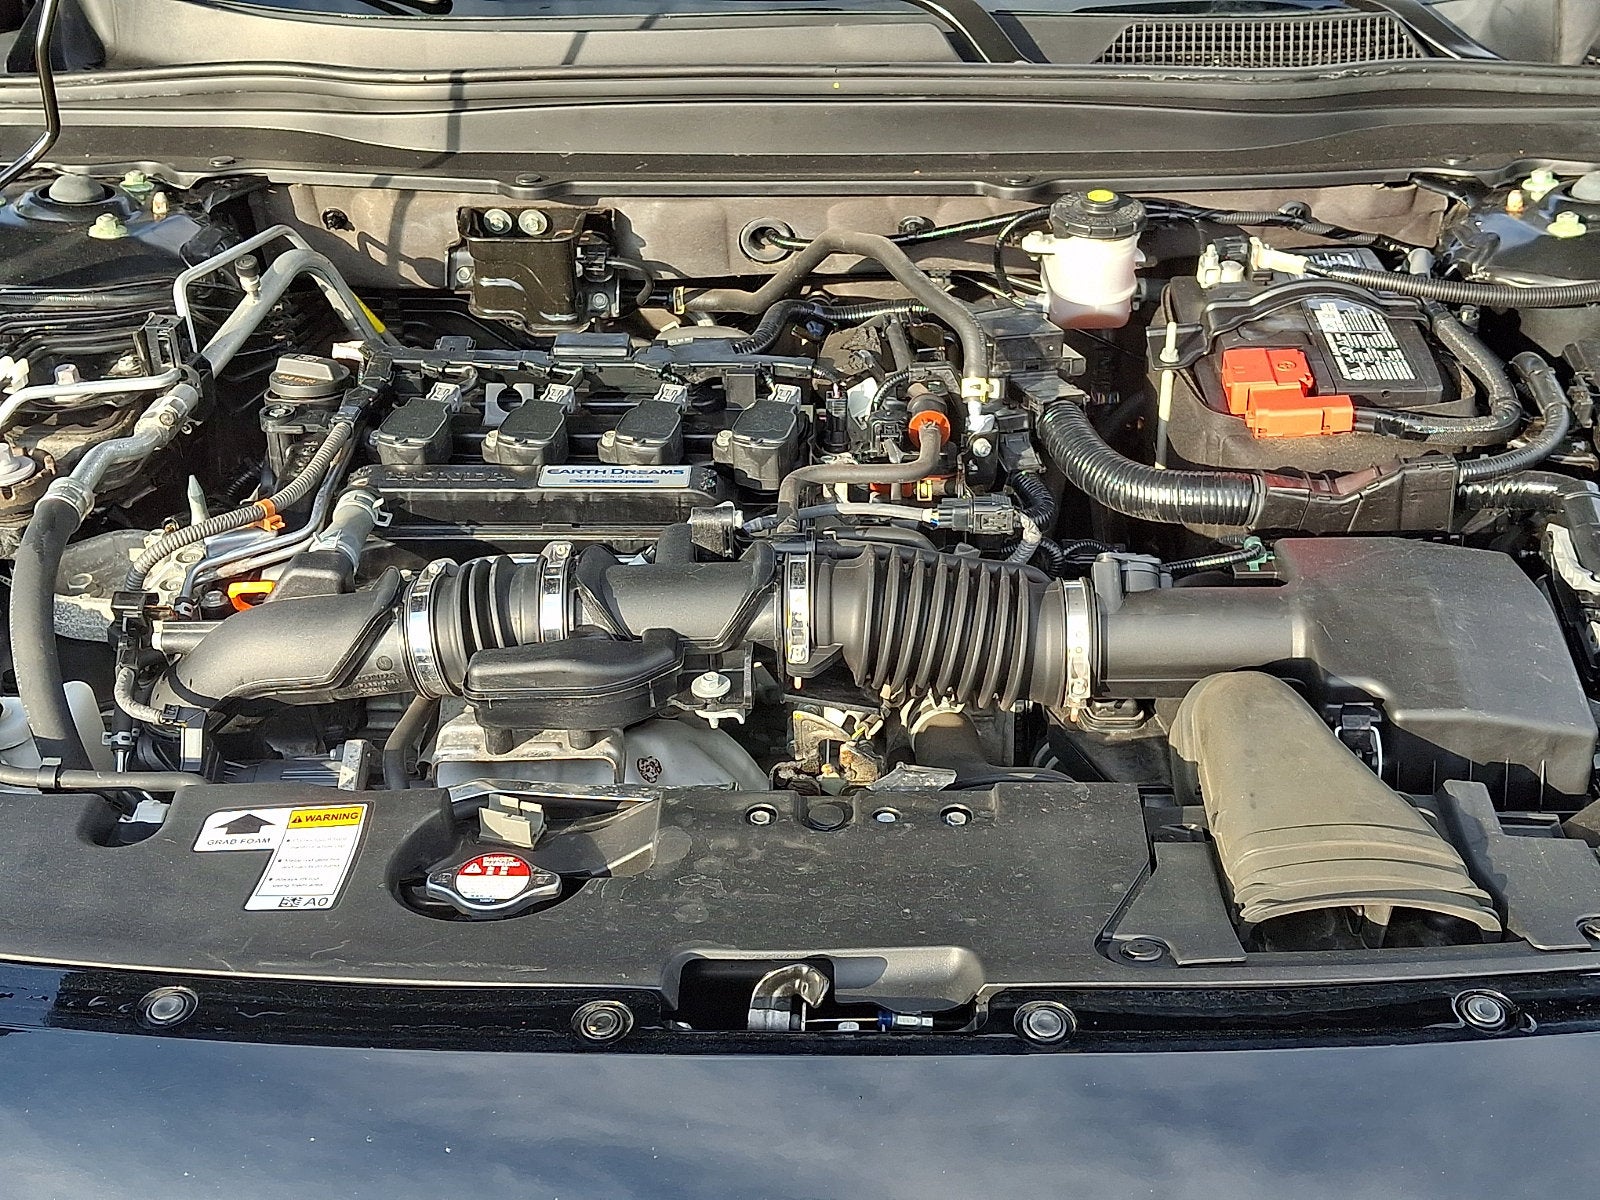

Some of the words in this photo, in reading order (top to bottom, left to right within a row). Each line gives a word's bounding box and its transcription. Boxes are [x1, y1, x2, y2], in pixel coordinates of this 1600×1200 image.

[385, 471, 516, 482] HONDA
[305, 812, 359, 822] WARNING
[207, 838, 237, 846] GRAB
[239, 837, 271, 845] FOAM
